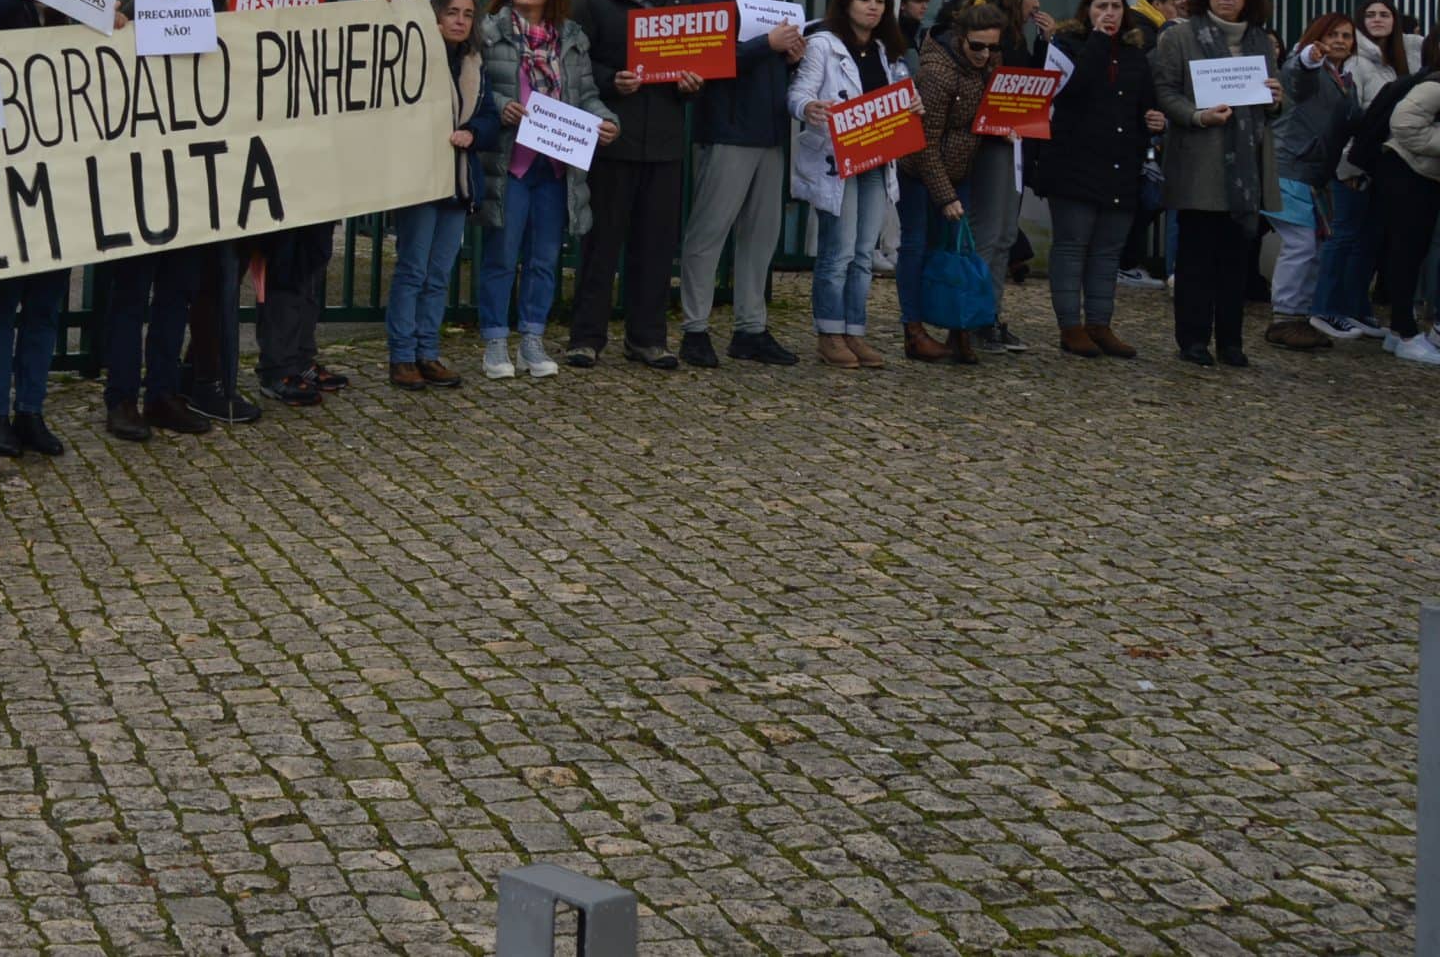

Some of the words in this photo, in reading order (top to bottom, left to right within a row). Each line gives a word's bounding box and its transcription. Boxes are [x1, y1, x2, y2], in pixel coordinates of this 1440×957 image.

[137, 7, 213, 21] PRECARIDADE
[634, 9, 729, 39] RESPEITO
[164, 24, 192, 37] NÃO!
[255, 20, 428, 122] PINHEIRO
[989, 73, 1056, 97] RESPEITO
[532, 103, 558, 120] Quem
[558, 115, 586, 131] ensina
[832, 87, 912, 135] RESPEITO
[85, 135, 285, 252] LUTA
